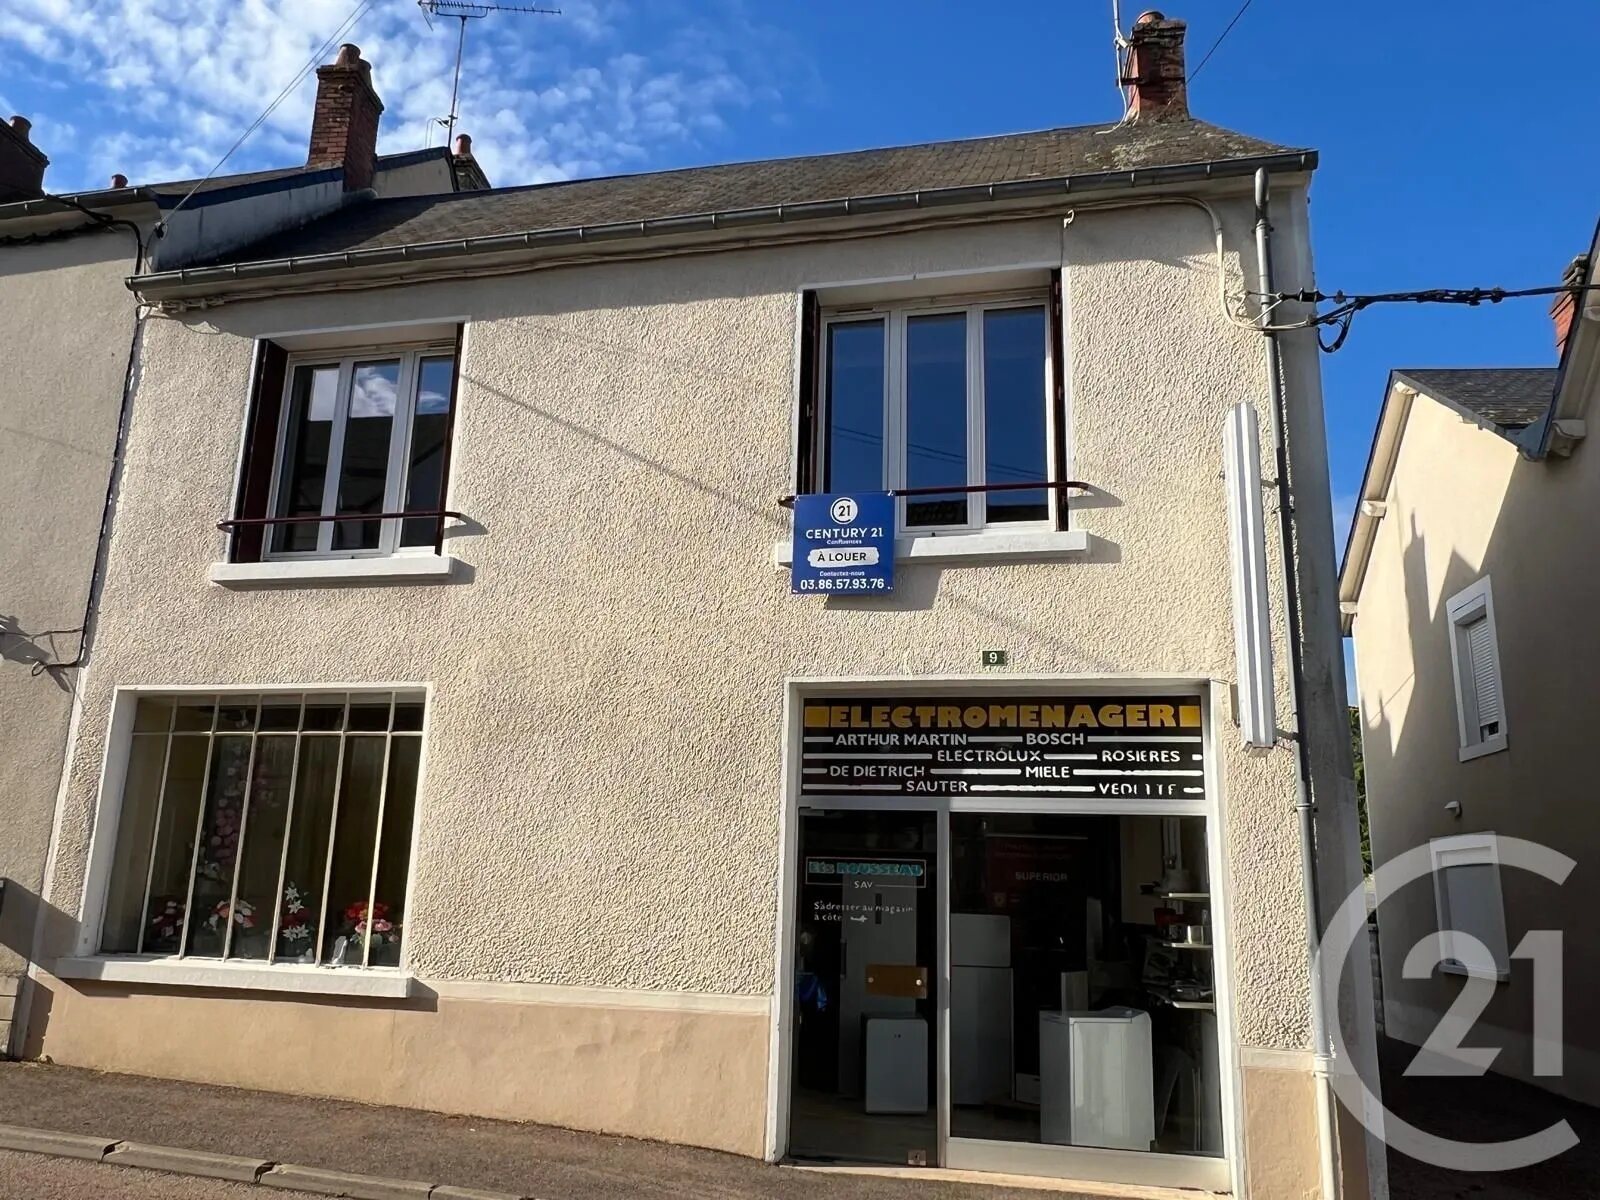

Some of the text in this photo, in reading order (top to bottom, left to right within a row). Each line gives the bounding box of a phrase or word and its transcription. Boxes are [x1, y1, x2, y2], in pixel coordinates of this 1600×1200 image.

[838, 504, 851, 517] 21
[805, 527, 884, 539] CENTURY 21
[828, 552, 867, 561] LOUER
[800, 578, 885, 590] 03.86.57.93.76
[989, 651, 998, 664] 9
[830, 704, 1176, 728] ELECTROMENAGER
[835, 732, 1084, 746] ARTHUR MARTIN BOSCH
[937, 749, 1181, 762] ELECTROLUX ROSIERES
[830, 766, 1070, 778] DE DIETRICH MIELE
[906, 781, 968, 792] SAUTER
[836, 862, 924, 877] ROUSSEAU
[854, 880, 873, 889] SAV
